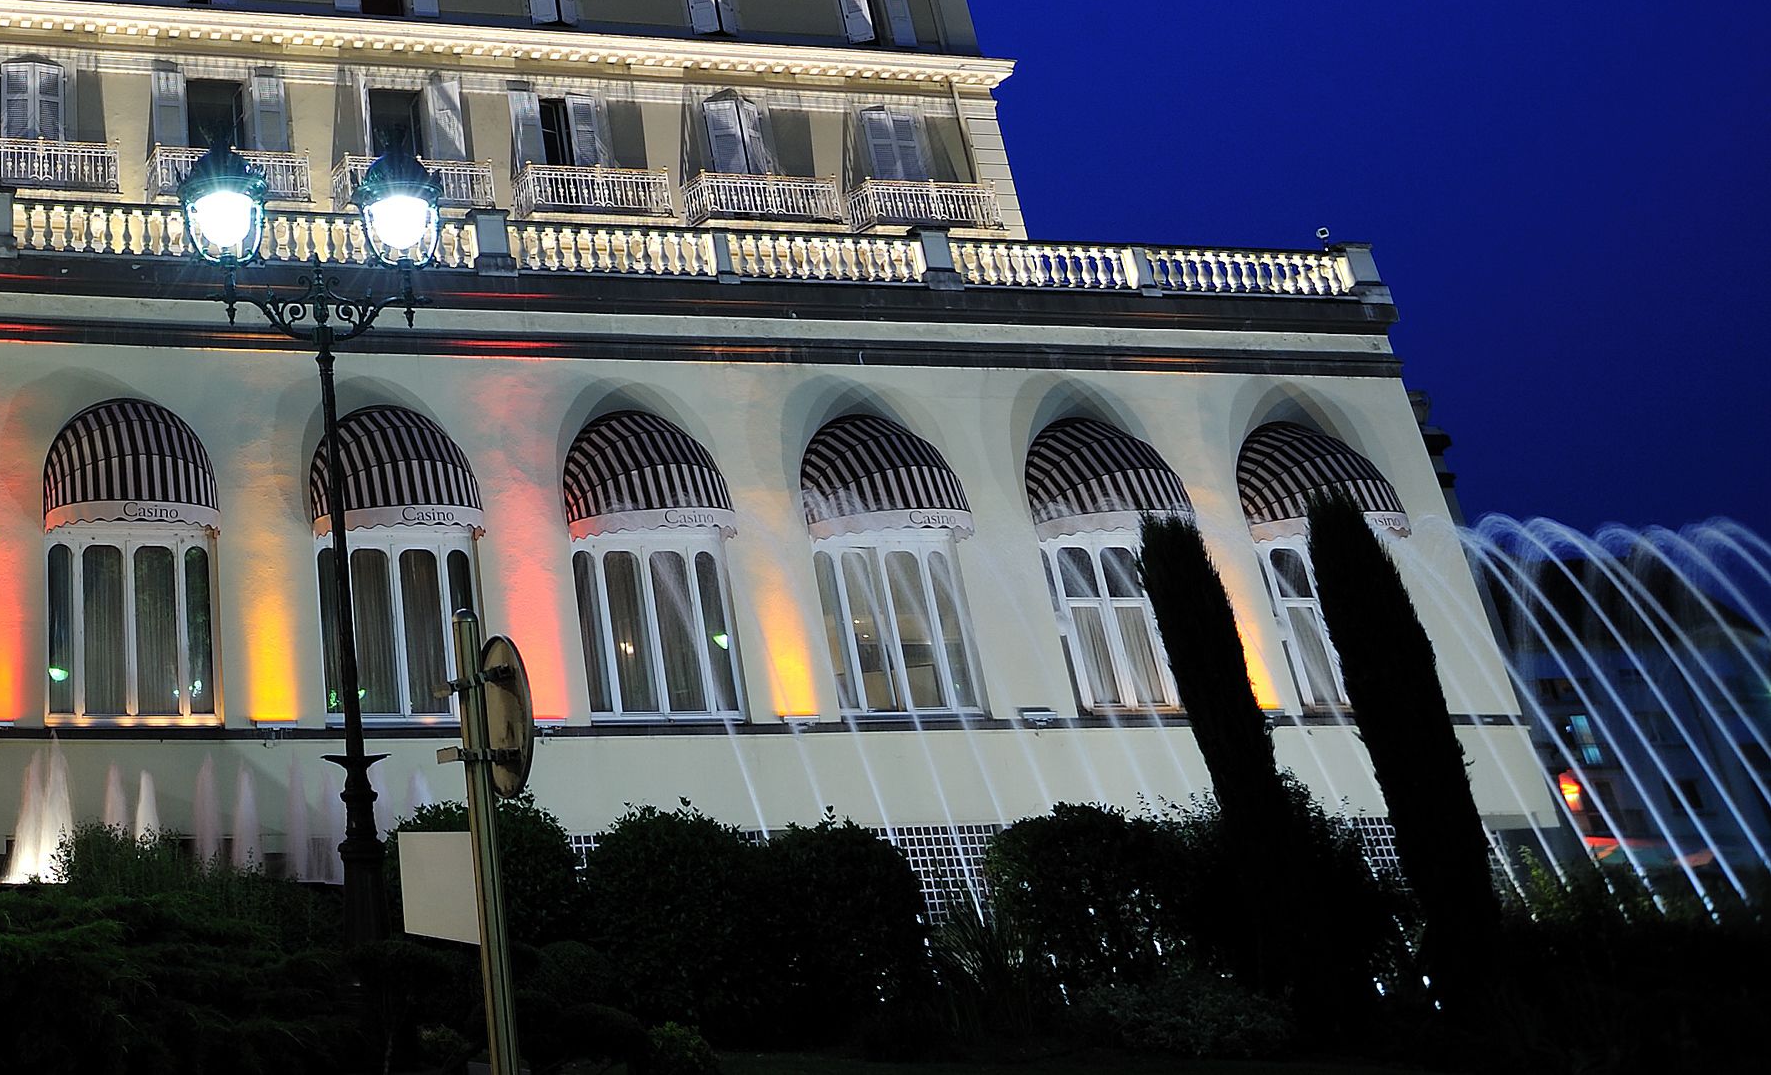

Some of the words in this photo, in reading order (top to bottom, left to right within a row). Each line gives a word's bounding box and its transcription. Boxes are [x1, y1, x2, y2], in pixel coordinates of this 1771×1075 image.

[123, 501, 179, 518] Casino
[402, 506, 455, 521] Casino
[664, 509, 714, 524] Casino
[909, 510, 956, 525] Casino
